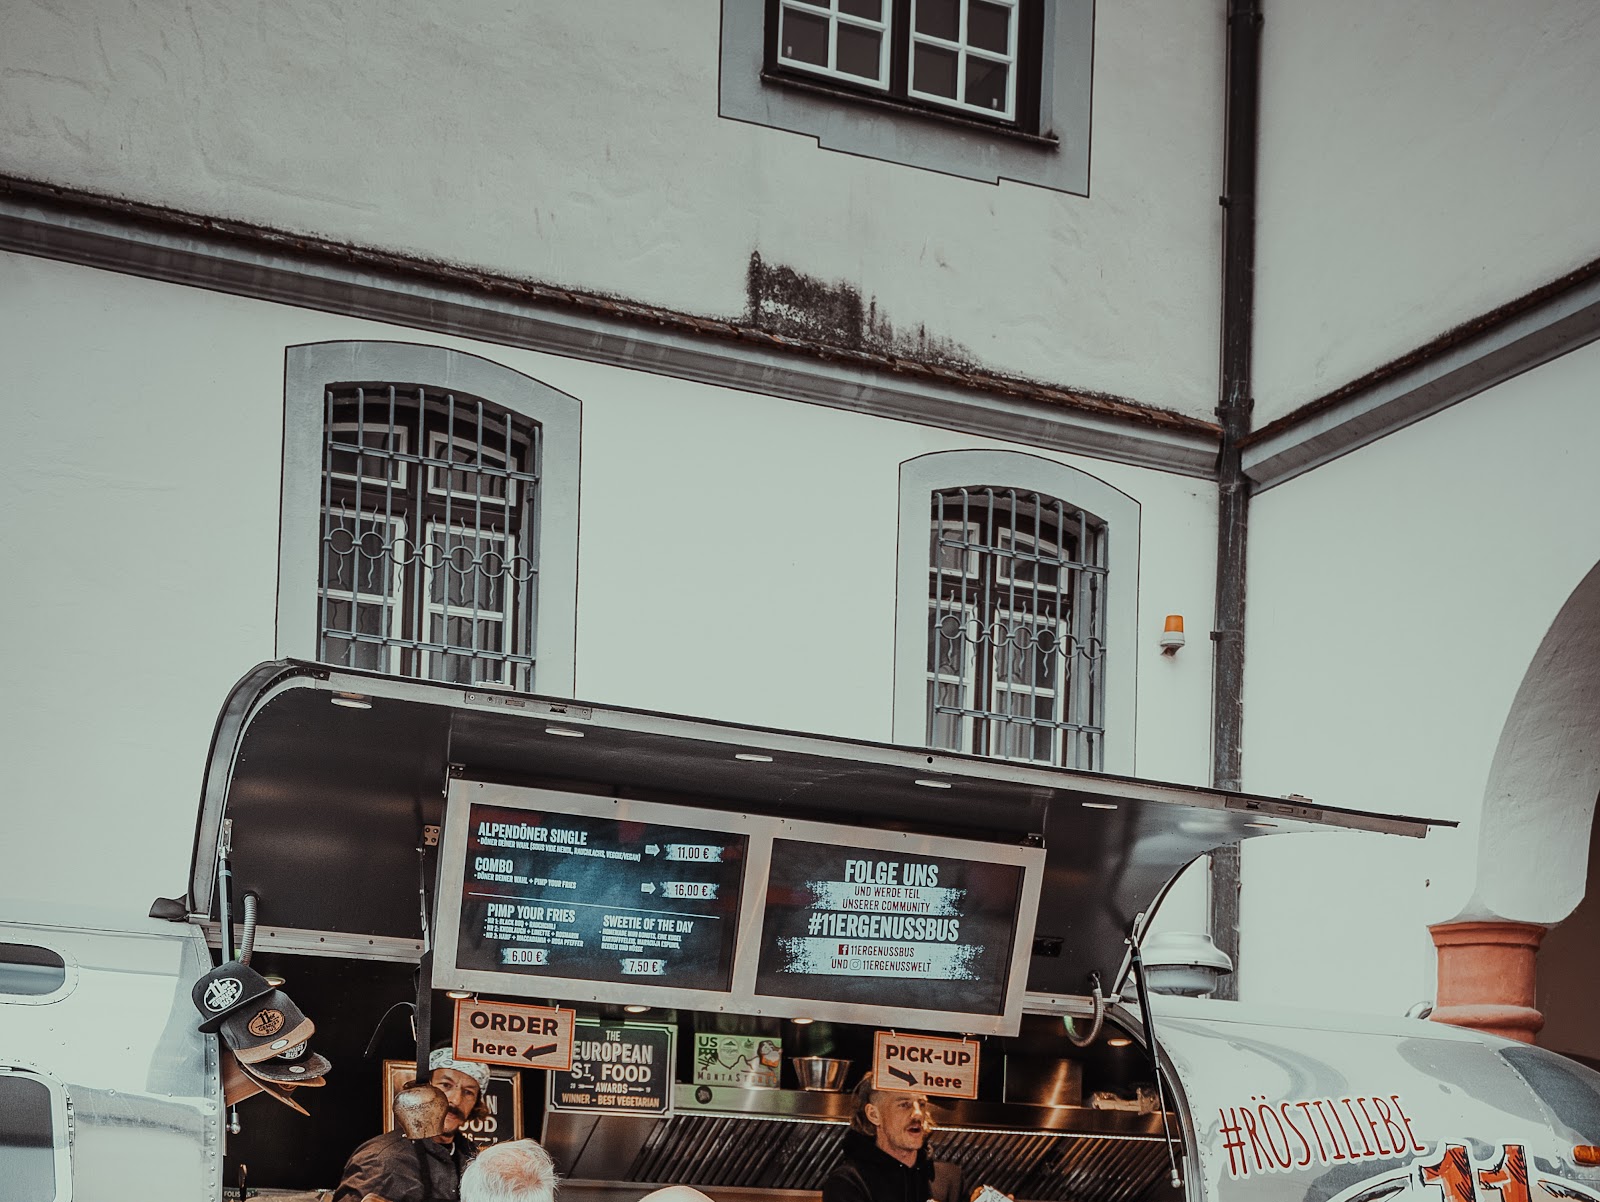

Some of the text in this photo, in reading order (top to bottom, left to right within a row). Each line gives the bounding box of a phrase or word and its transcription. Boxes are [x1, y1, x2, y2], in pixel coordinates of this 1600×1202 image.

[478, 822, 588, 846] ALPENDÖNER SINGLE
[678, 847, 710, 860] 11,00 €
[475, 857, 514, 873] COMBO
[844, 859, 939, 888] FOLGE UNS
[675, 884, 708, 896] 16,00 €
[854, 886, 920, 899] UND WERDE TEIL
[487, 903, 576, 923] PIMP YOUR FRIES
[842, 899, 930, 913] UNSERER COMMUNITY
[603, 915, 694, 933] SWEETIE OF THE DAY
[808, 912, 960, 942] #11ERGENUSSBUS
[536, 951, 543, 962] €
[851, 945, 915, 958] 11ERGENUSSBUS
[630, 961, 658, 973] 7,50 €
[831, 959, 932, 973] UND 11ERGENUSSWELT
[470, 1011, 558, 1037] ORDER
[606, 1030, 621, 1041] THE
[699, 1037, 718, 1048] US
[473, 1038, 517, 1057] here
[572, 1041, 653, 1065] EUROPEAN
[886, 1045, 971, 1067] PICK-UP
[602, 1064, 651, 1082] FOOD
[923, 1072, 962, 1088] here
[595, 1082, 628, 1094] AWARDS
[562, 1093, 590, 1104] WINNER
[597, 1094, 615, 1106] BEST
[617, 1095, 660, 1108] VEGETARIAN
[1219, 1095, 1426, 1176] #RÖSTILIEBE
